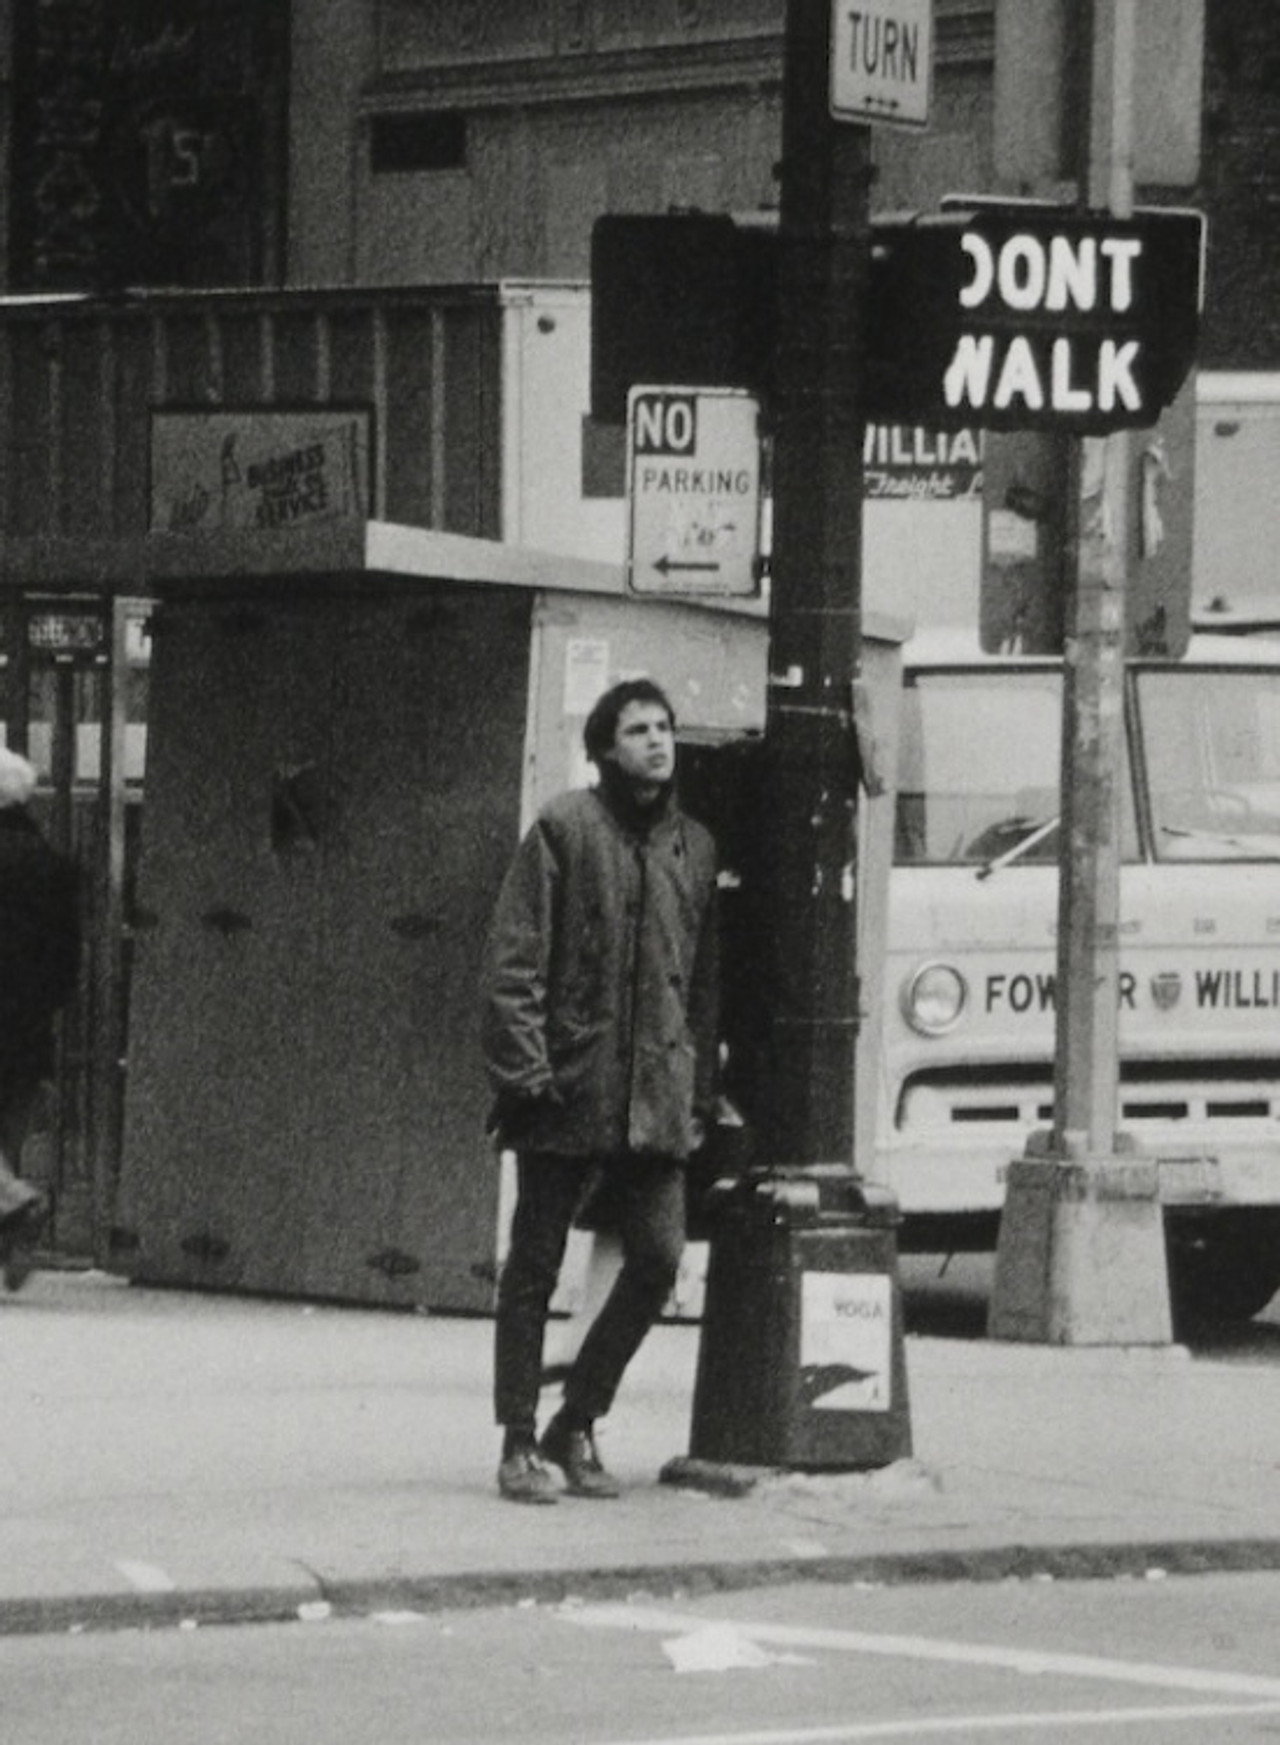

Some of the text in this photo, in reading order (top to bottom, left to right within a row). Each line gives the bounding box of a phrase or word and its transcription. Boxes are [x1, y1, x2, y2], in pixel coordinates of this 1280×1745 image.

[847, 10, 919, 83] TURN
[636, 401, 693, 450] NO
[863, 422, 985, 465] ILLIA
[642, 468, 751, 495] PARKING
[985, 970, 1137, 1013] FOWR
